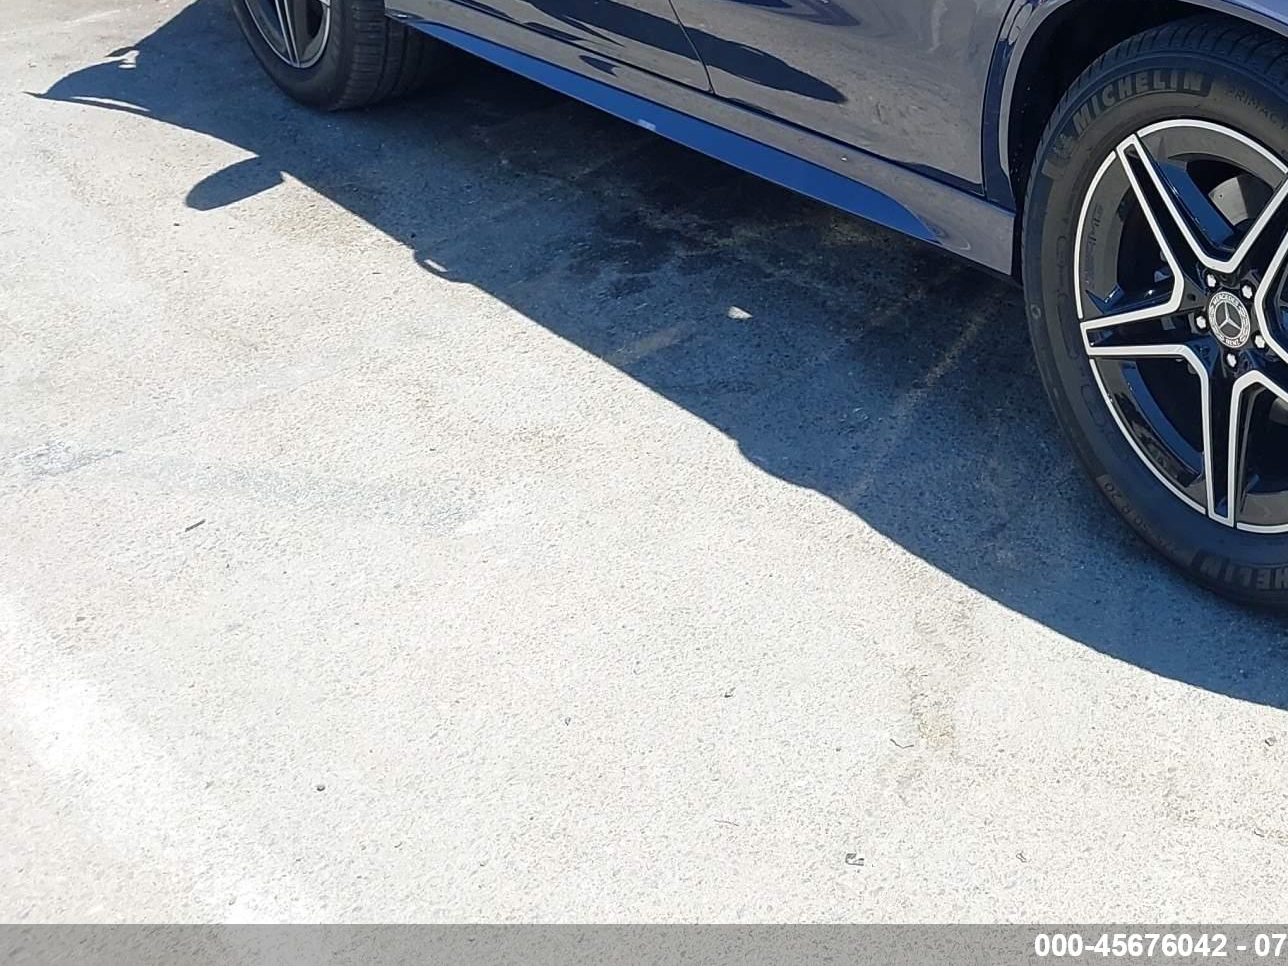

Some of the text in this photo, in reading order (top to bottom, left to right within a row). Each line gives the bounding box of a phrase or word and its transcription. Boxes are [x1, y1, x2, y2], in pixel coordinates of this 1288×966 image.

[1072, 70, 1204, 135] MICHELIN
[1224, 88, 1287, 130] PRIMACY
[1212, 294, 1240, 306] MERCEDES
[1225, 338, 1240, 346] BENZ
